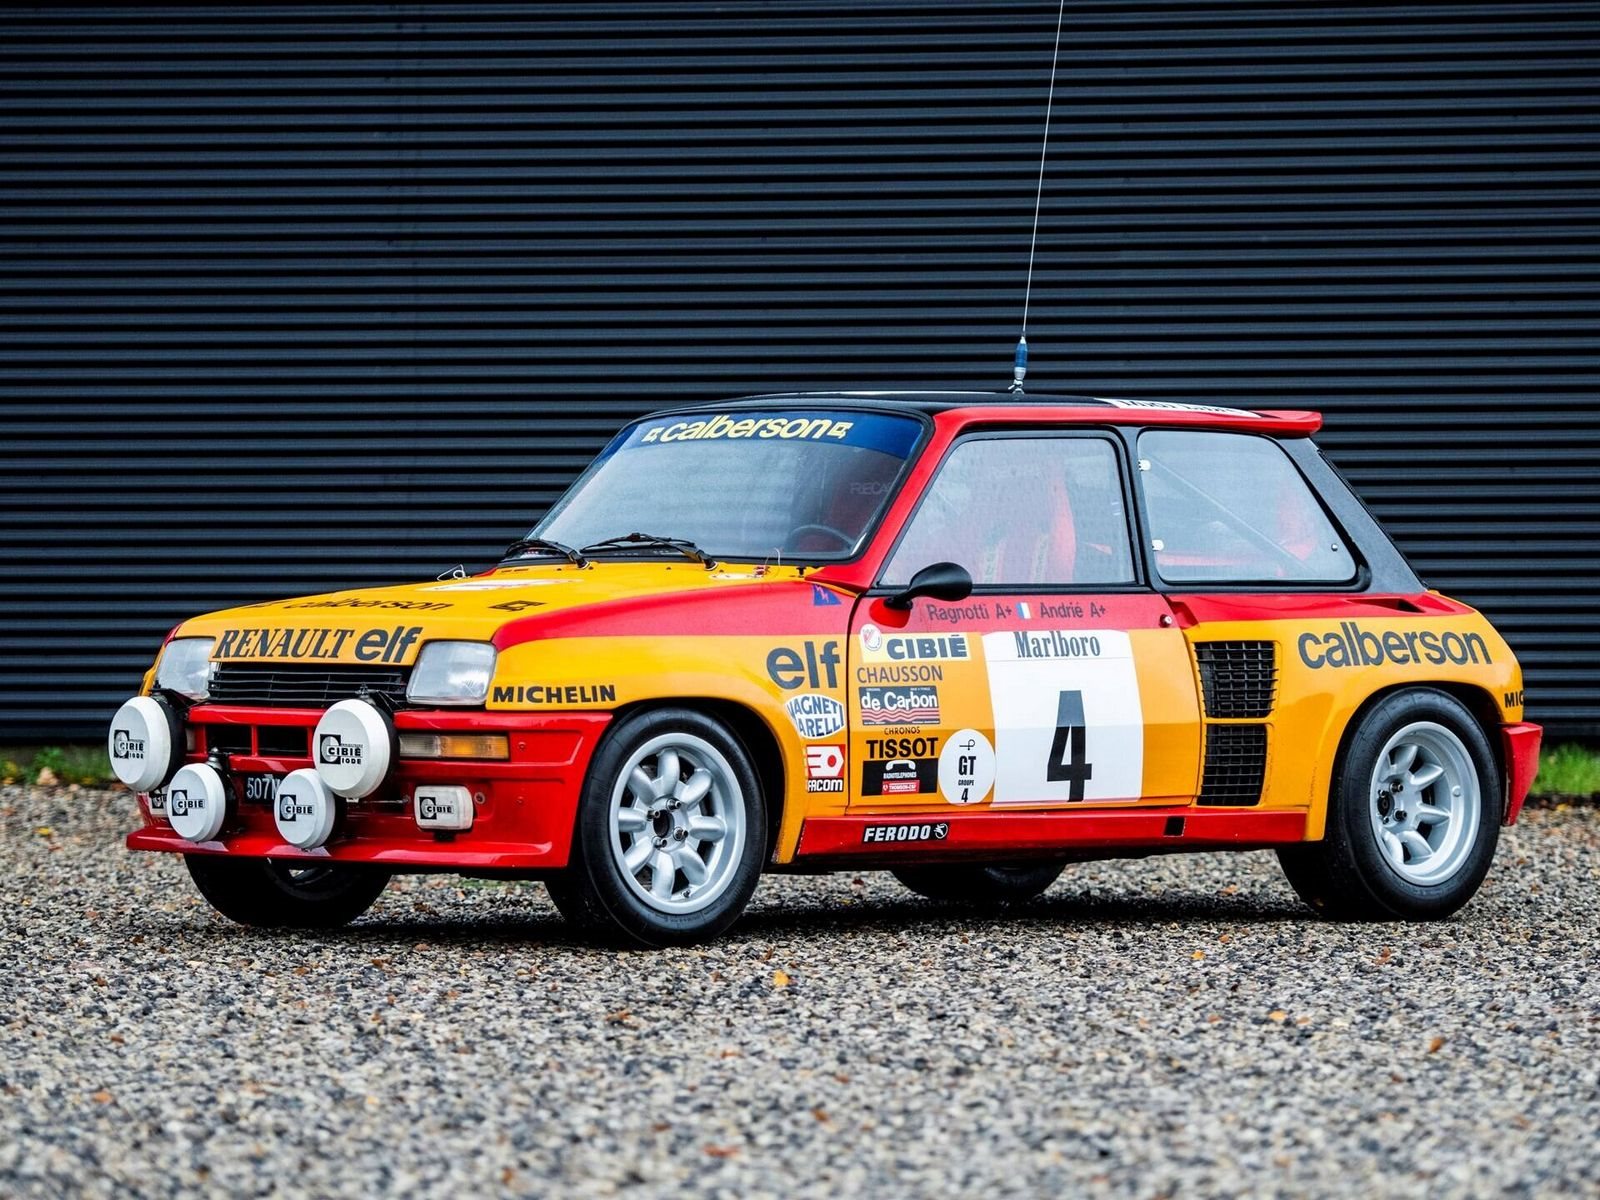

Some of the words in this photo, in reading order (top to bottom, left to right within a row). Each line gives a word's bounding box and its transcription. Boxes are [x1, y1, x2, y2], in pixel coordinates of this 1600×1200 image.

[661, 415, 832, 442] calberson
[283, 598, 454, 611] calberson
[927, 604, 989, 623] Ragnotti
[995, 603, 1012, 618] A+
[1090, 602, 1106, 617] A+
[213, 628, 354, 659] RENAULT
[355, 626, 422, 662] elf
[1014, 630, 1101, 659] Marlboro
[1298, 622, 1492, 669] calberson
[766, 641, 840, 690] elf
[857, 665, 943, 684] CHAUSSON
[492, 685, 616, 703] MICHELIN
[861, 691, 881, 711] de
[884, 691, 937, 711] Carbon
[884, 726, 921, 735] CHRONOS
[866, 737, 939, 759] TISSOT
[1047, 690, 1092, 802] 4
[958, 755, 977, 776] GT
[807, 779, 843, 792] FACOM
[961, 787, 969, 802] 4
[863, 824, 931, 842] FERODO
